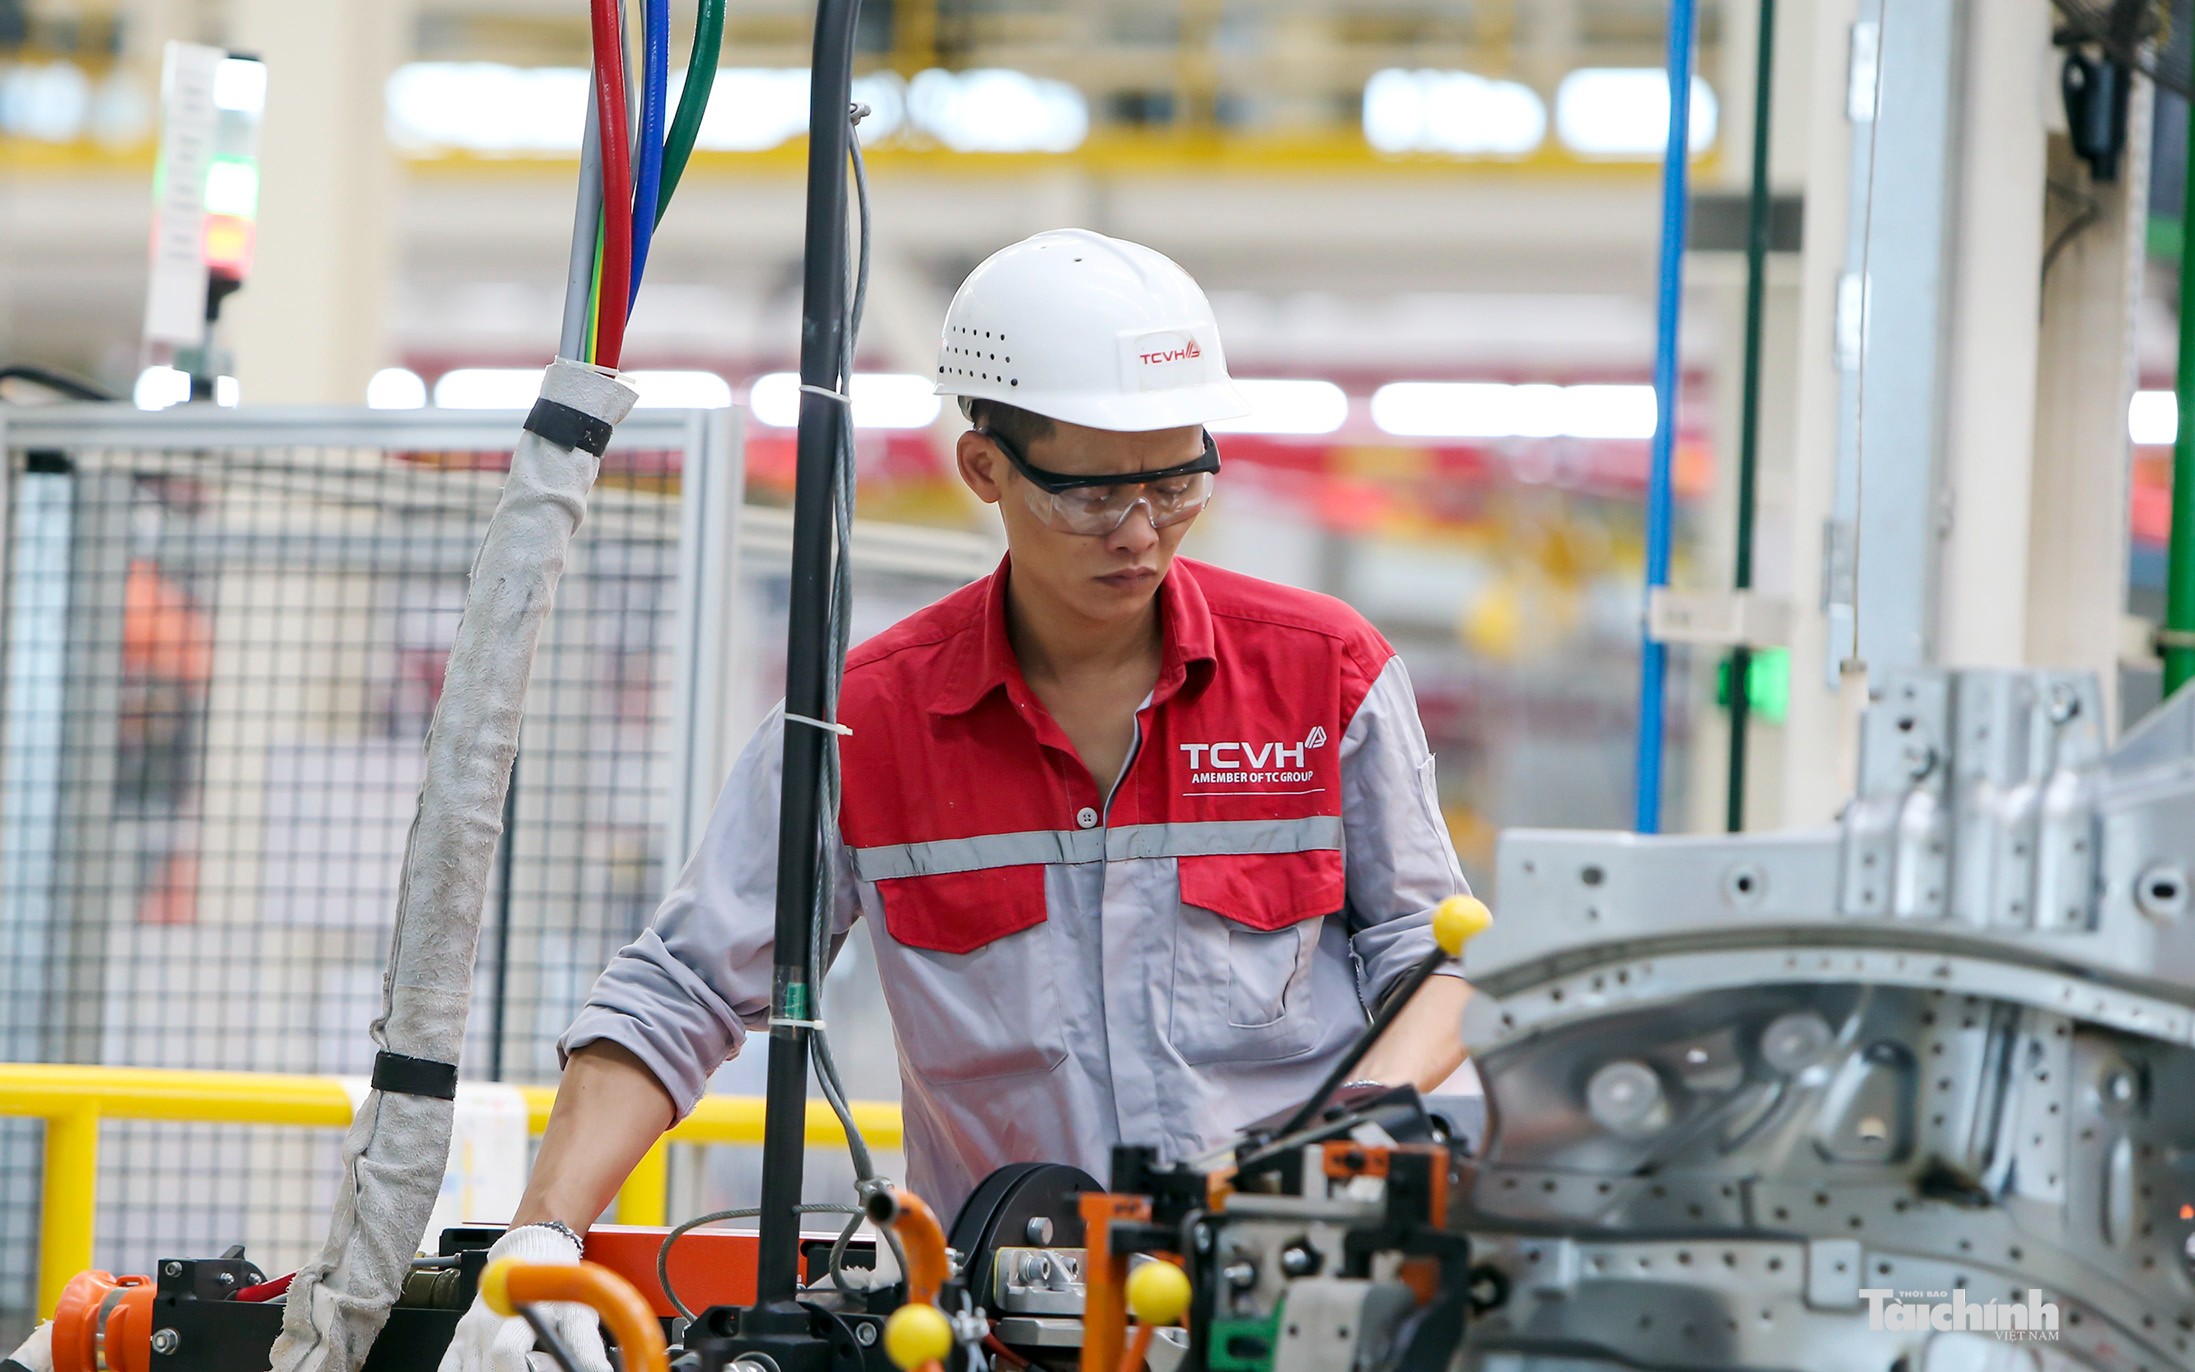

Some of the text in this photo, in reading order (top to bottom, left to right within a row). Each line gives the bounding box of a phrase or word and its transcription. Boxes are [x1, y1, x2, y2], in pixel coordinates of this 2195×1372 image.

[1140, 349, 1185, 365] TCVH
[1180, 741, 1305, 769] TCVH
[1249, 772, 1264, 783] OF
[1265, 772, 1279, 783] TC
[1280, 770, 1314, 782] GROUP
